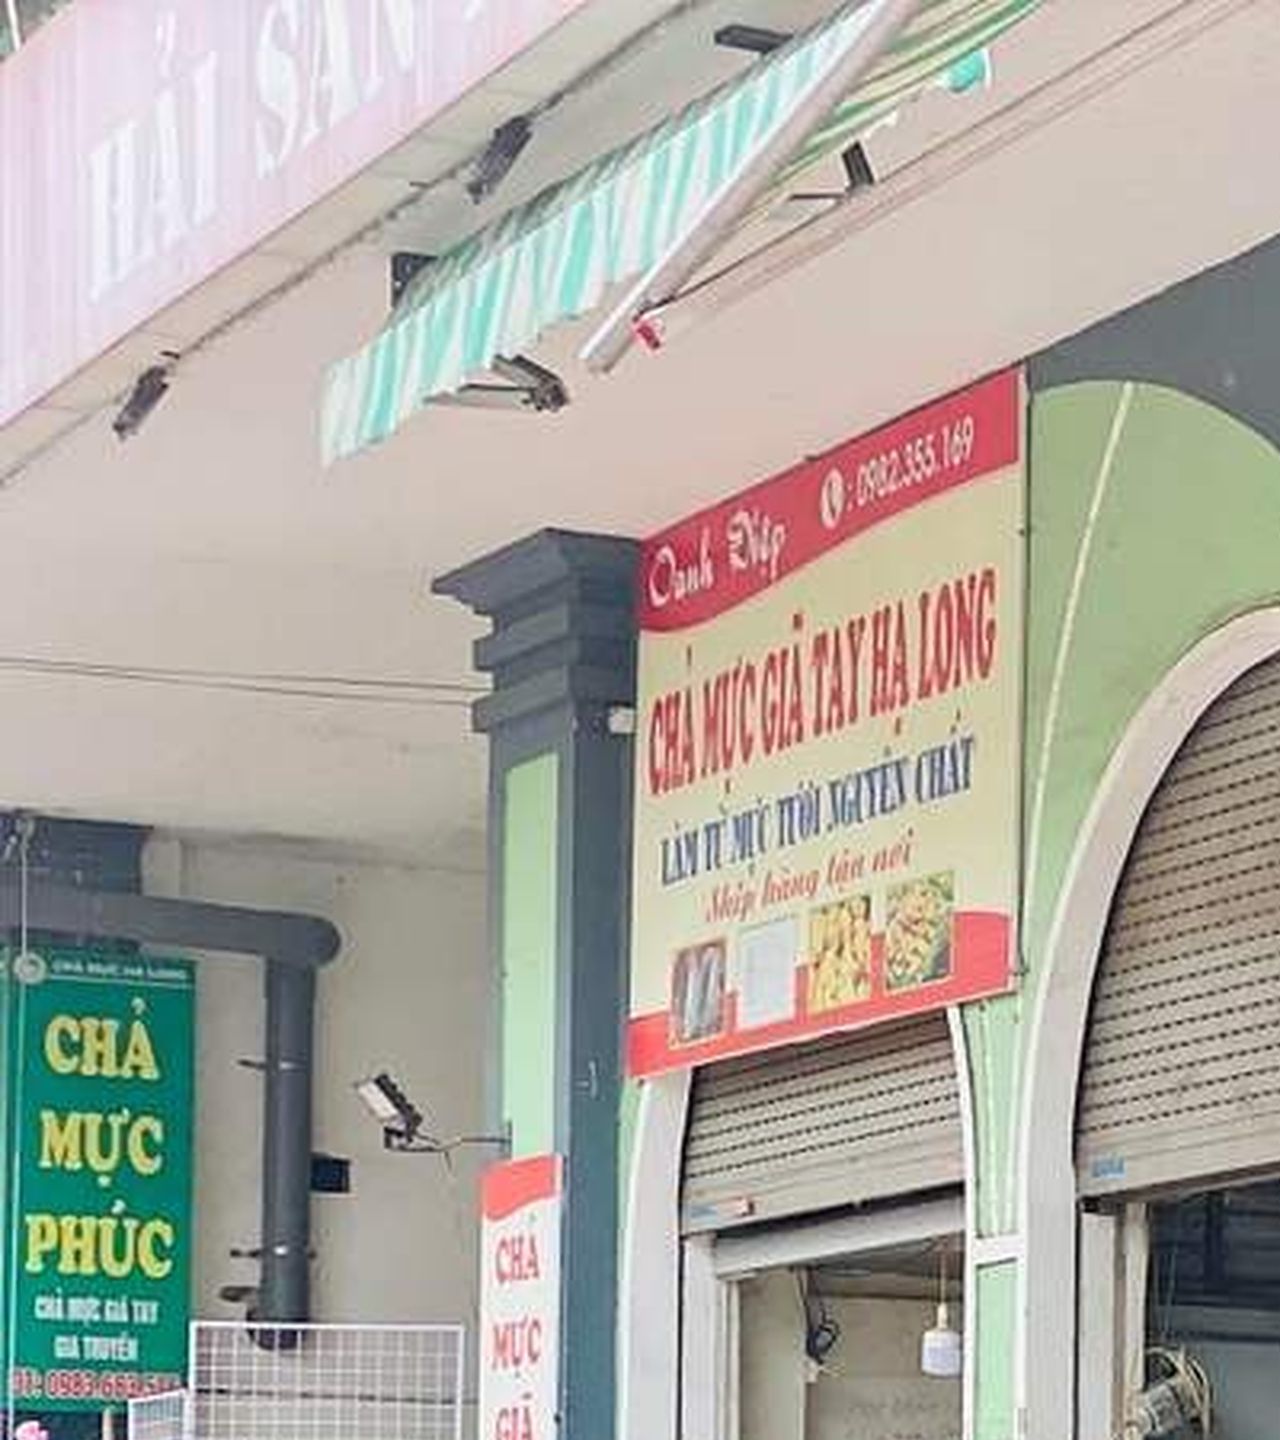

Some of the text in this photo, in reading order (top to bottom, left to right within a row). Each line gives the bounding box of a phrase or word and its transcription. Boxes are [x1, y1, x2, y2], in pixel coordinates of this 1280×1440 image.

[648, 567, 997, 796] CHẢ MỰC GIÃ TAY HẠ LONG
[44, 997, 160, 1080] CHẢ
[39, 1107, 164, 1187] MỰC
[24, 1199, 174, 1279] PHÚC
[495, 1213, 540, 1286] CHẢ
